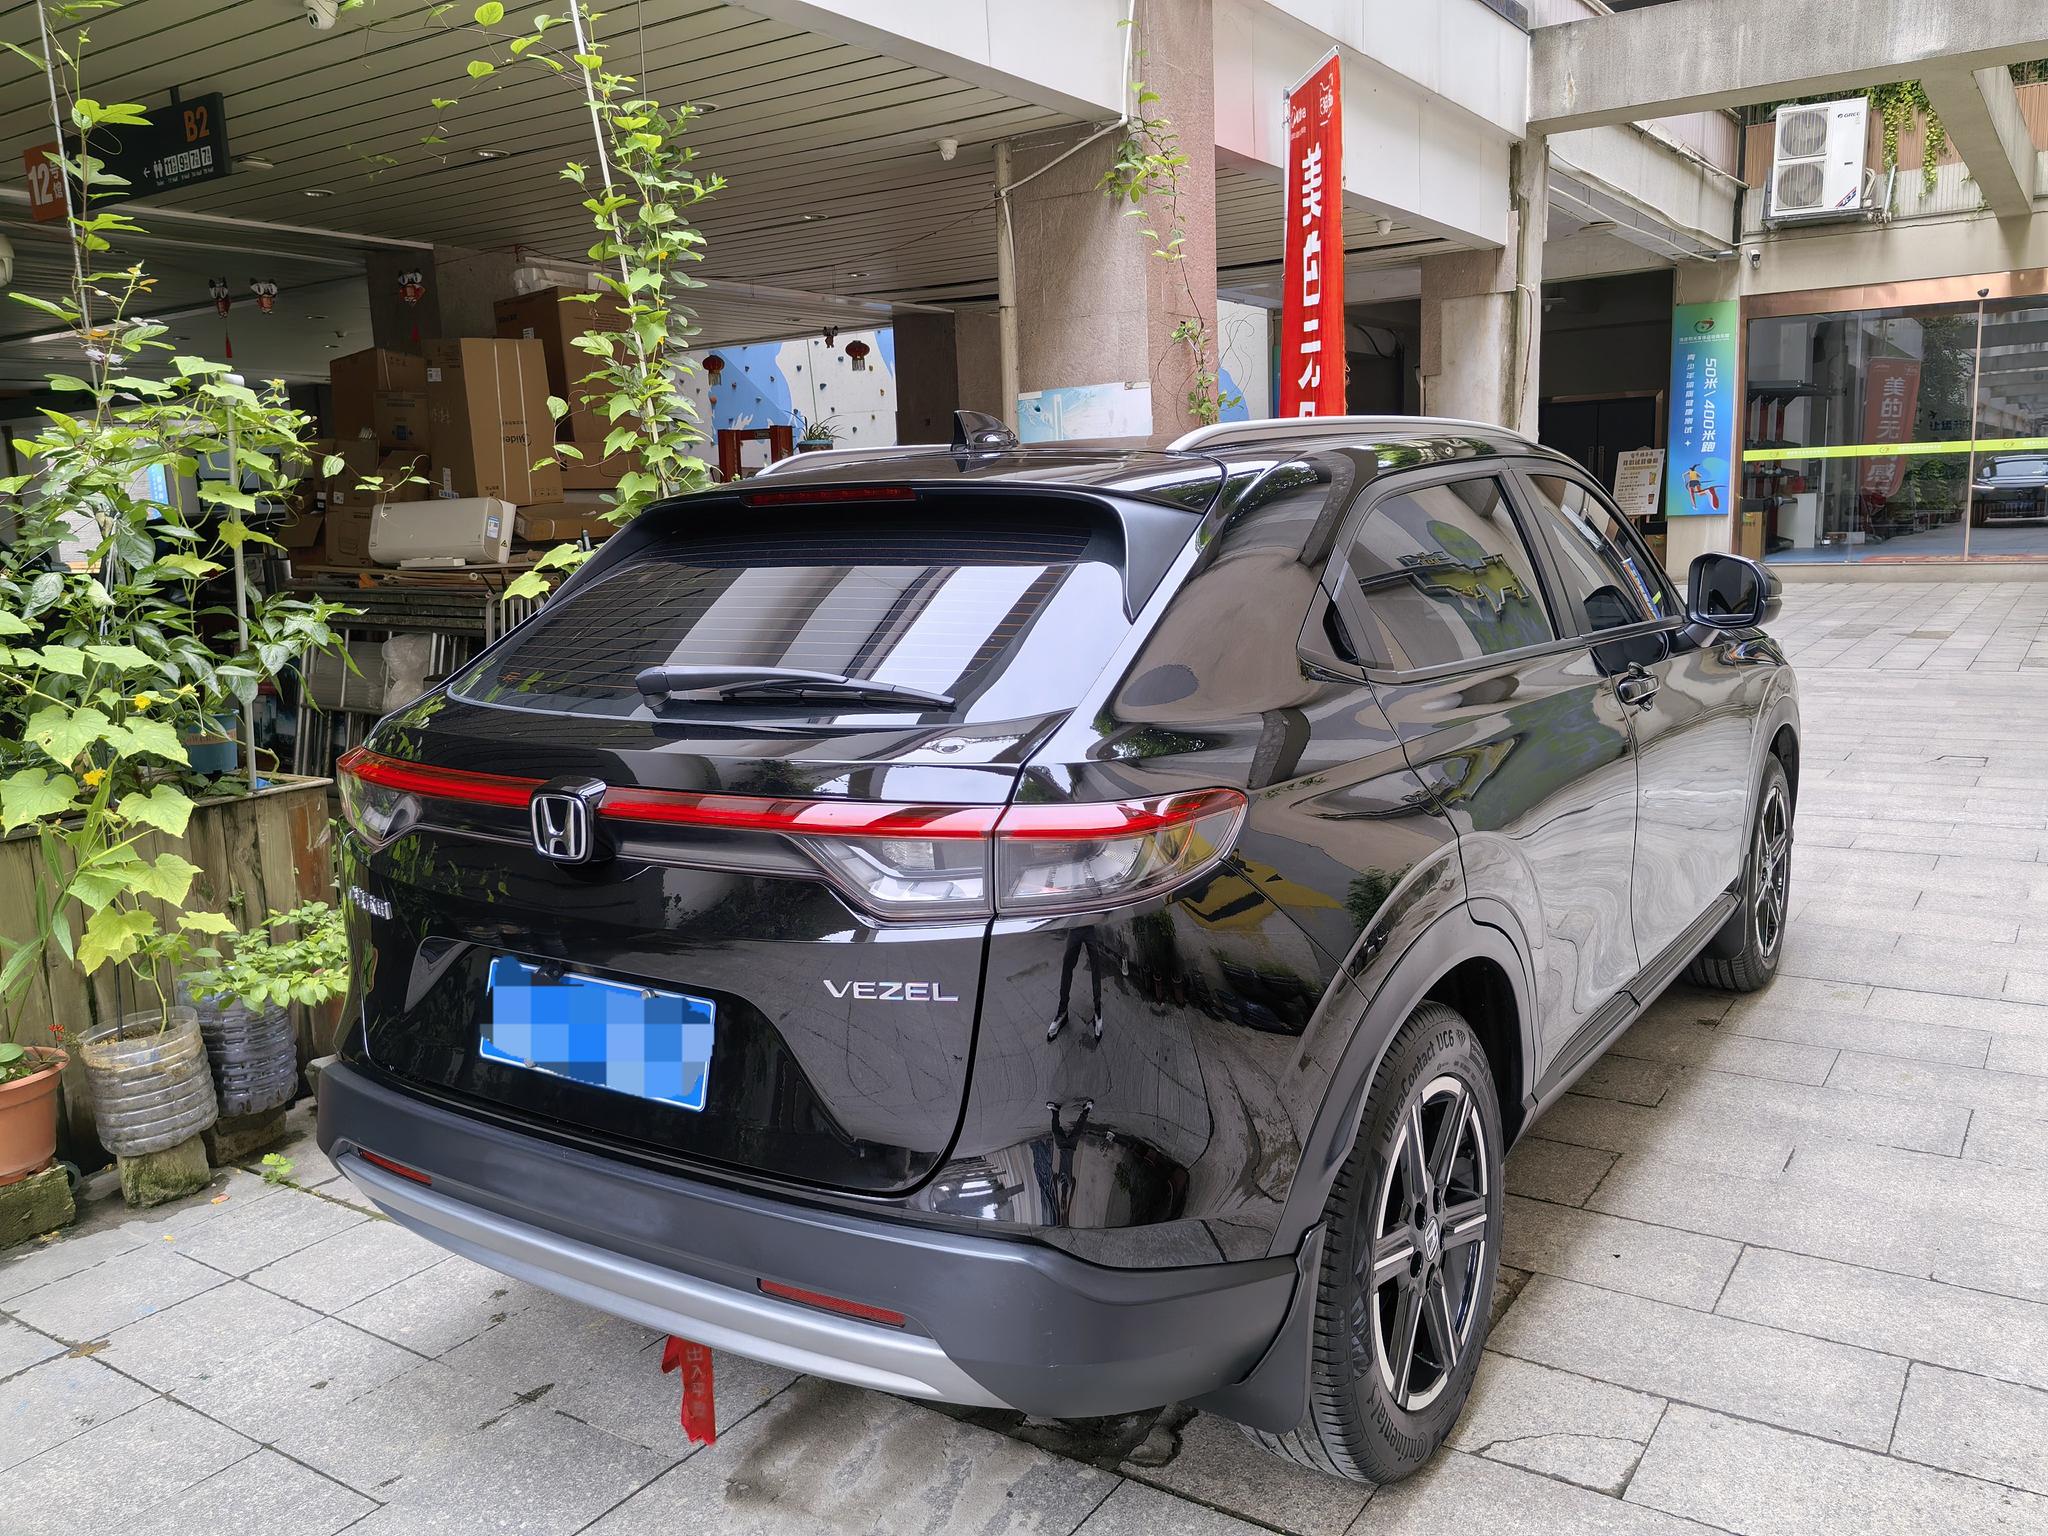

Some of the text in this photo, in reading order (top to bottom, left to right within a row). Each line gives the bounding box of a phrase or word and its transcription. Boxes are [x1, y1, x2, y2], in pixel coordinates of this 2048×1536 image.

[184, 105, 210, 142] B2
[1866, 376, 1906, 483] 美的无感
[823, 979, 959, 1002] VEZEL
[1382, 1029, 1455, 1143] UltraContact UC6
[1371, 1397, 1428, 1463] Continental
